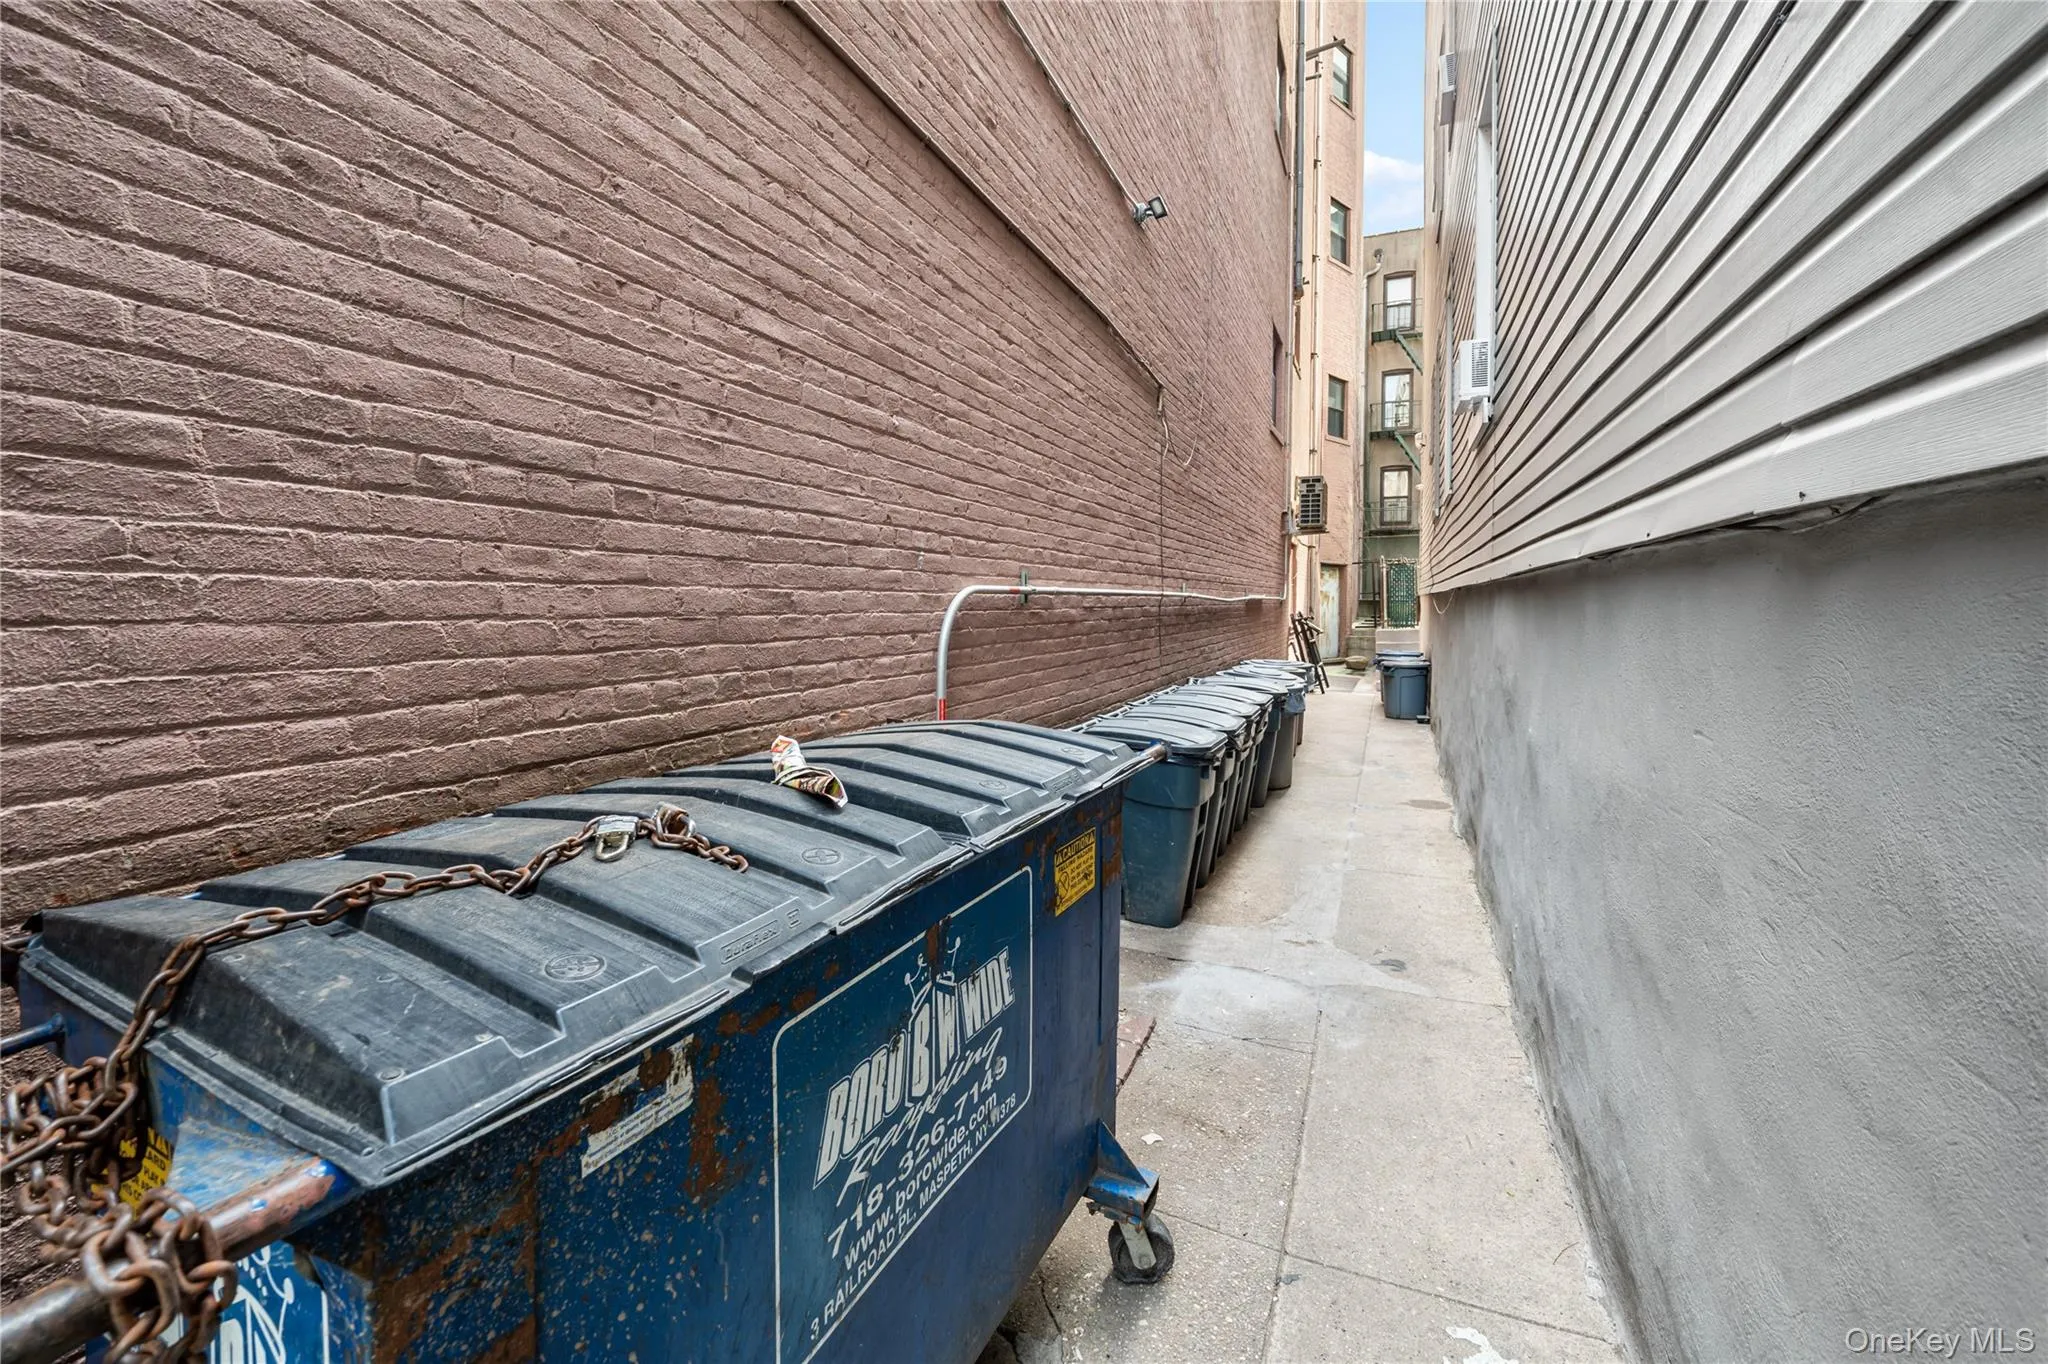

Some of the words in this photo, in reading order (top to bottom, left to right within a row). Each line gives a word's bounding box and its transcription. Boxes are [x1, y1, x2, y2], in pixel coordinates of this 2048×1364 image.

[1062, 833, 1089, 858] CAUTION
[814, 1029, 908, 1188] BORO
[960, 947, 1015, 1043] WIDE
[828, 1056, 1008, 1258] 718-326-7149
[836, 1027, 1002, 1207] Recycling
[824, 1229, 895, 1326] RAILROAD
[919, 1140, 974, 1210] MASPETH,
[844, 1092, 997, 1270] www.borowide.com
